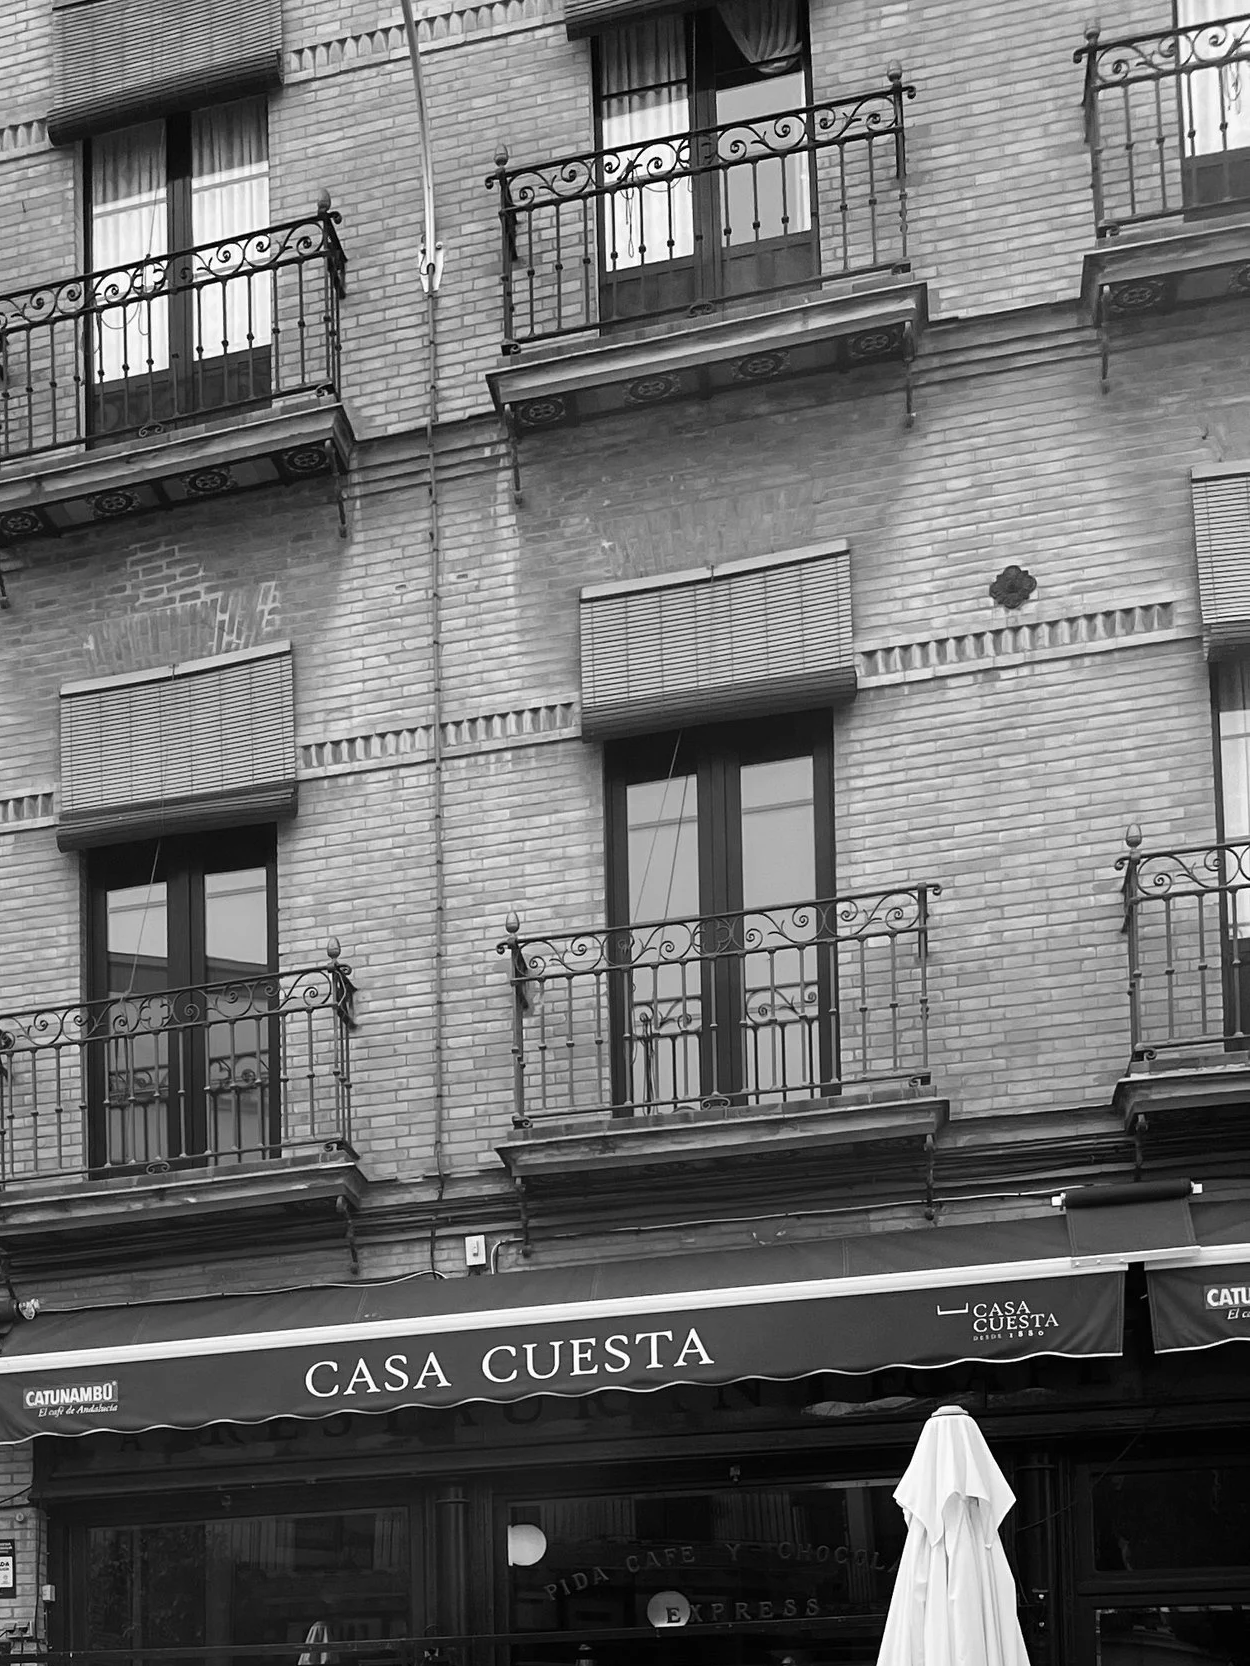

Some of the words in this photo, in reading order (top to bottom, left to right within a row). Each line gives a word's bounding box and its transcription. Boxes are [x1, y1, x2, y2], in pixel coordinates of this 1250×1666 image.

[973, 1300, 1031, 1318] CASA
[973, 1313, 1059, 1333] CUESTA
[304, 1351, 452, 1399] CASA
[481, 1327, 715, 1384] CUESTA
[65, 1404, 76, 1415] de
[543, 1567, 610, 1601] PIDA
[626, 1545, 696, 1574] CAFE
[725, 1543, 743, 1562] Y
[667, 1598, 821, 1623] EXPRESS
